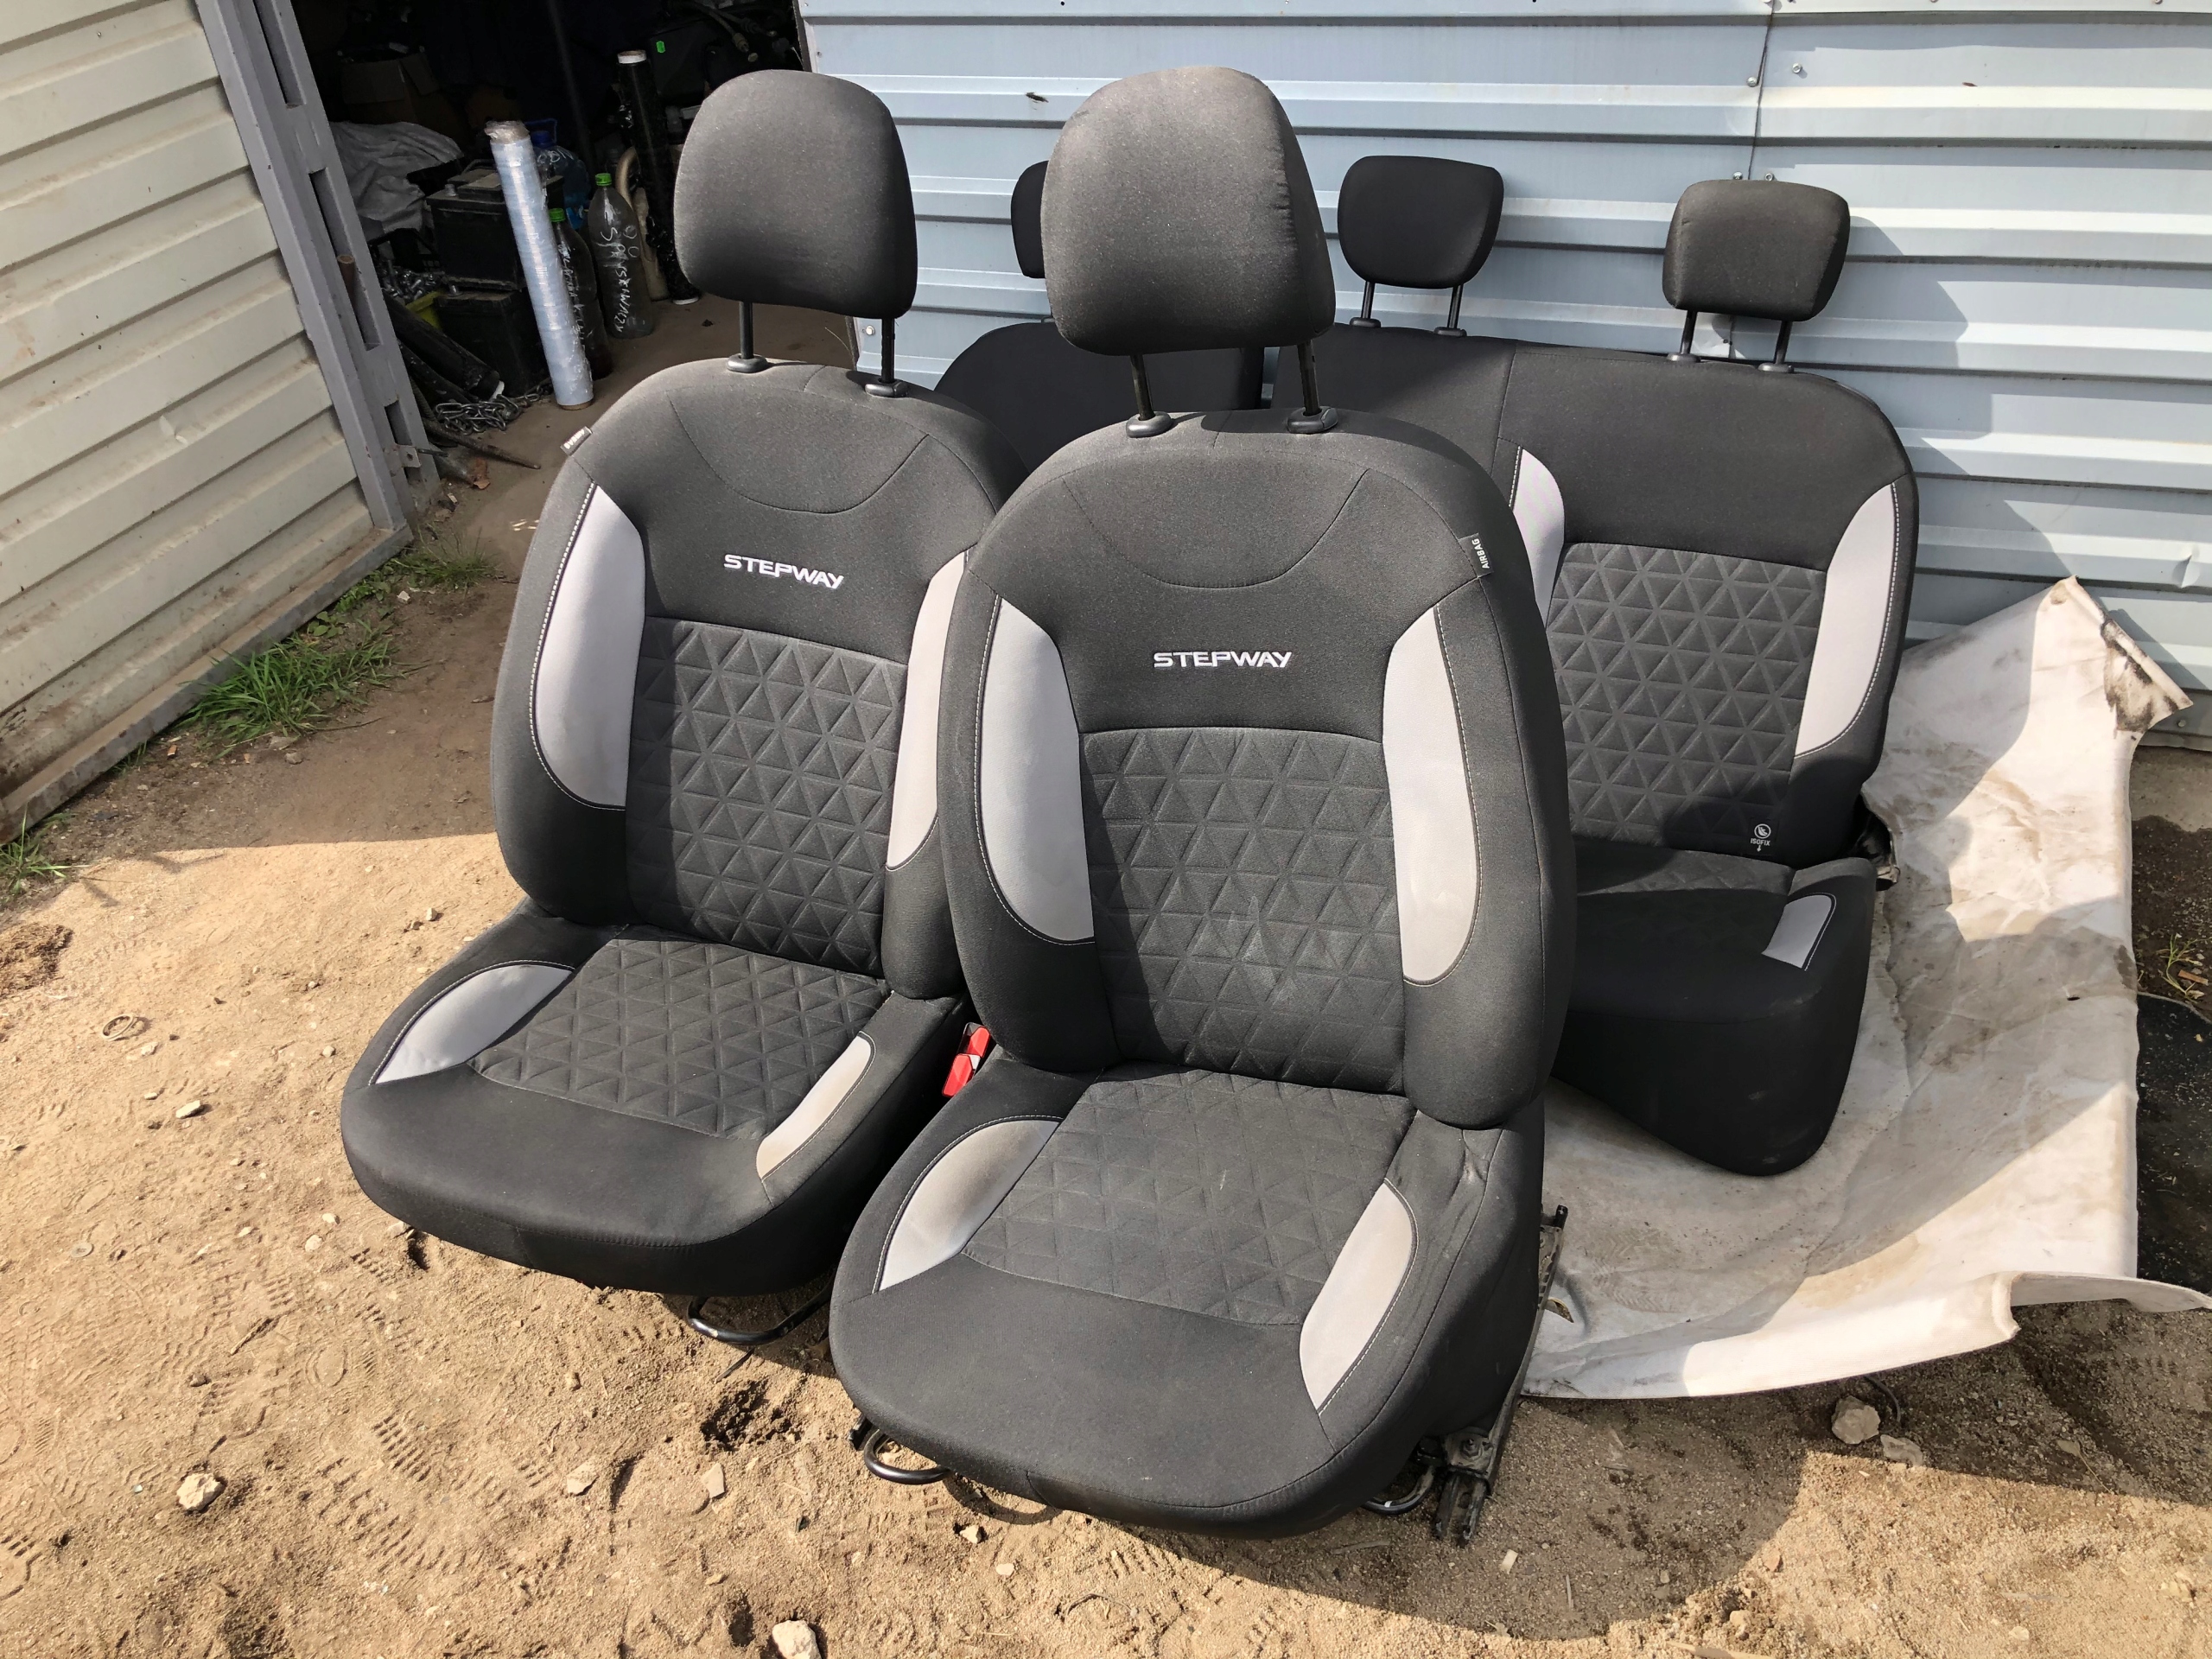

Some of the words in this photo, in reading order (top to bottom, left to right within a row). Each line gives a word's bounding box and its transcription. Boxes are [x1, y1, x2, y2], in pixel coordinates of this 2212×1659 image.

[1471, 538, 1491, 569] AIRBAG
[723, 554, 845, 589] STEPWAY
[1154, 651, 1293, 668] STEPWAY
[1750, 837, 1771, 847] ISOFIX
